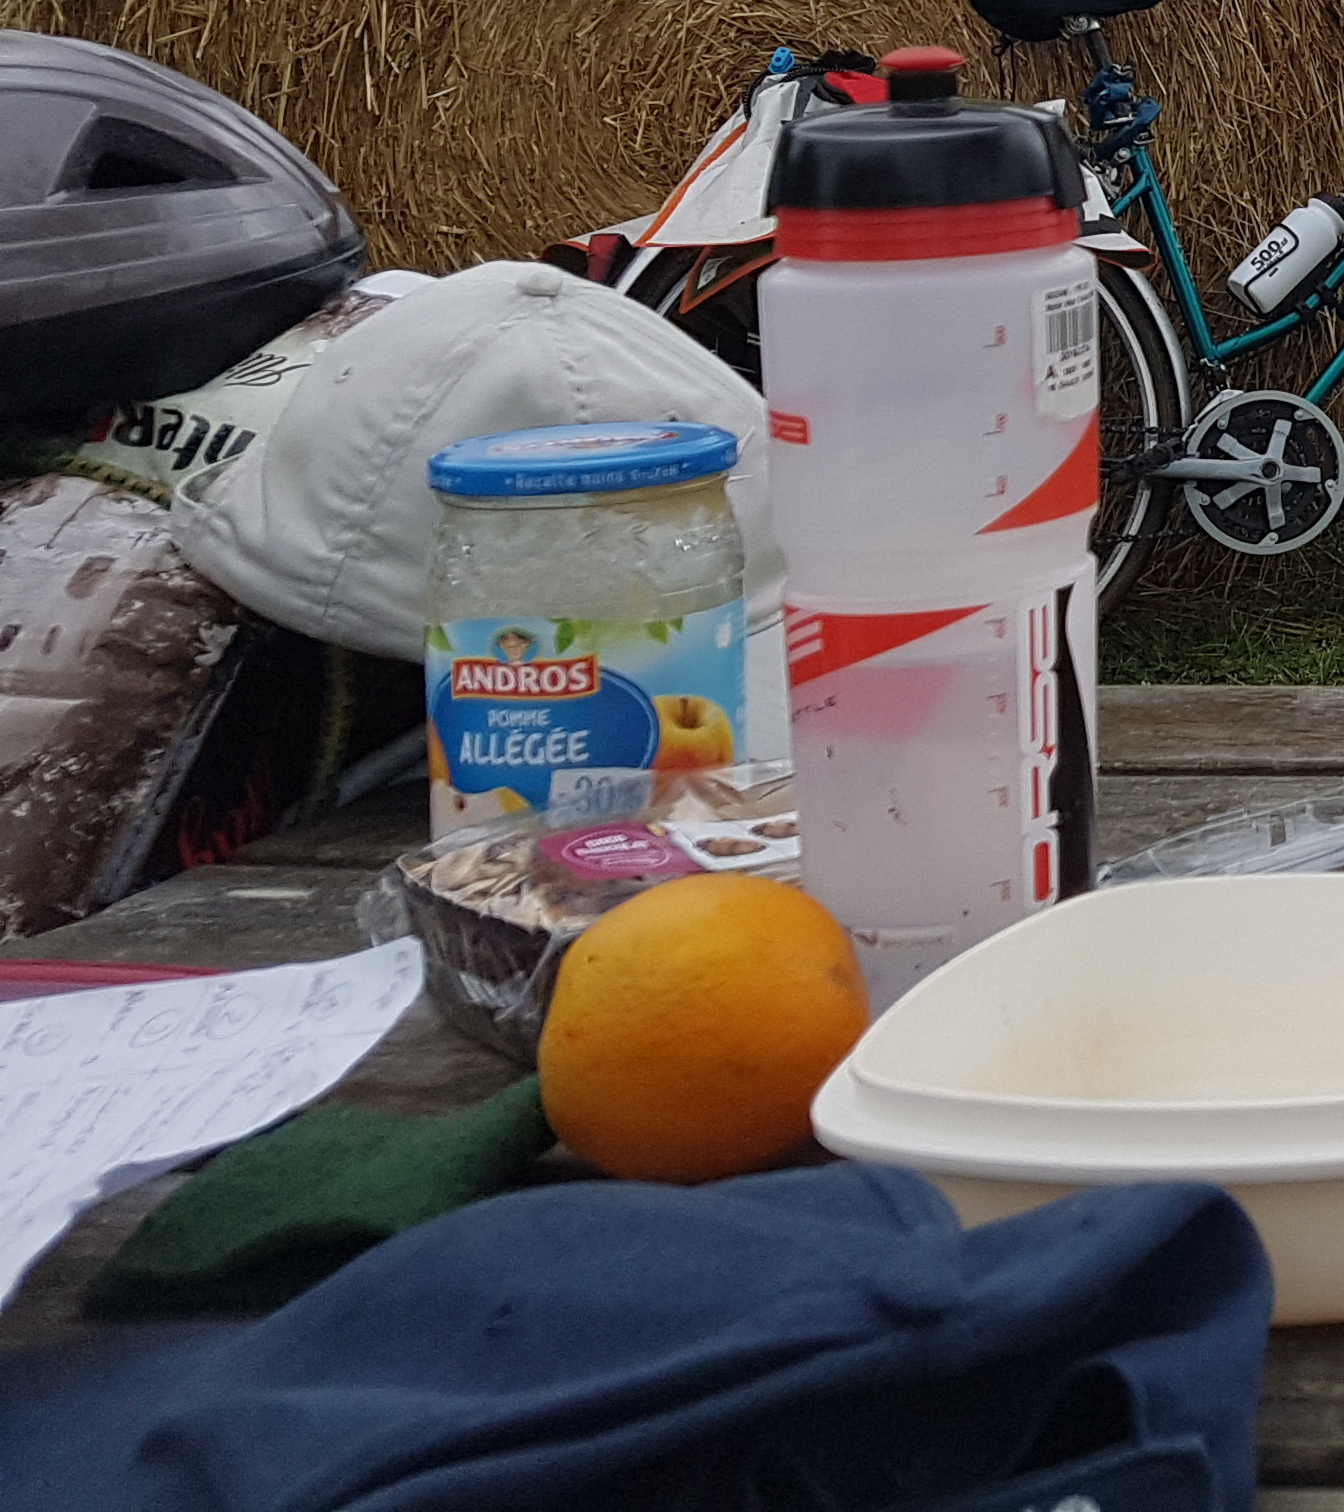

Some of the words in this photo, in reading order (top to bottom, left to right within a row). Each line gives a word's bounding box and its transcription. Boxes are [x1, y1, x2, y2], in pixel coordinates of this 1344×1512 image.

[456, 661, 590, 694] ANDROS
[487, 708, 552, 728] POMME
[459, 727, 591, 766] ALLÉGÉE
